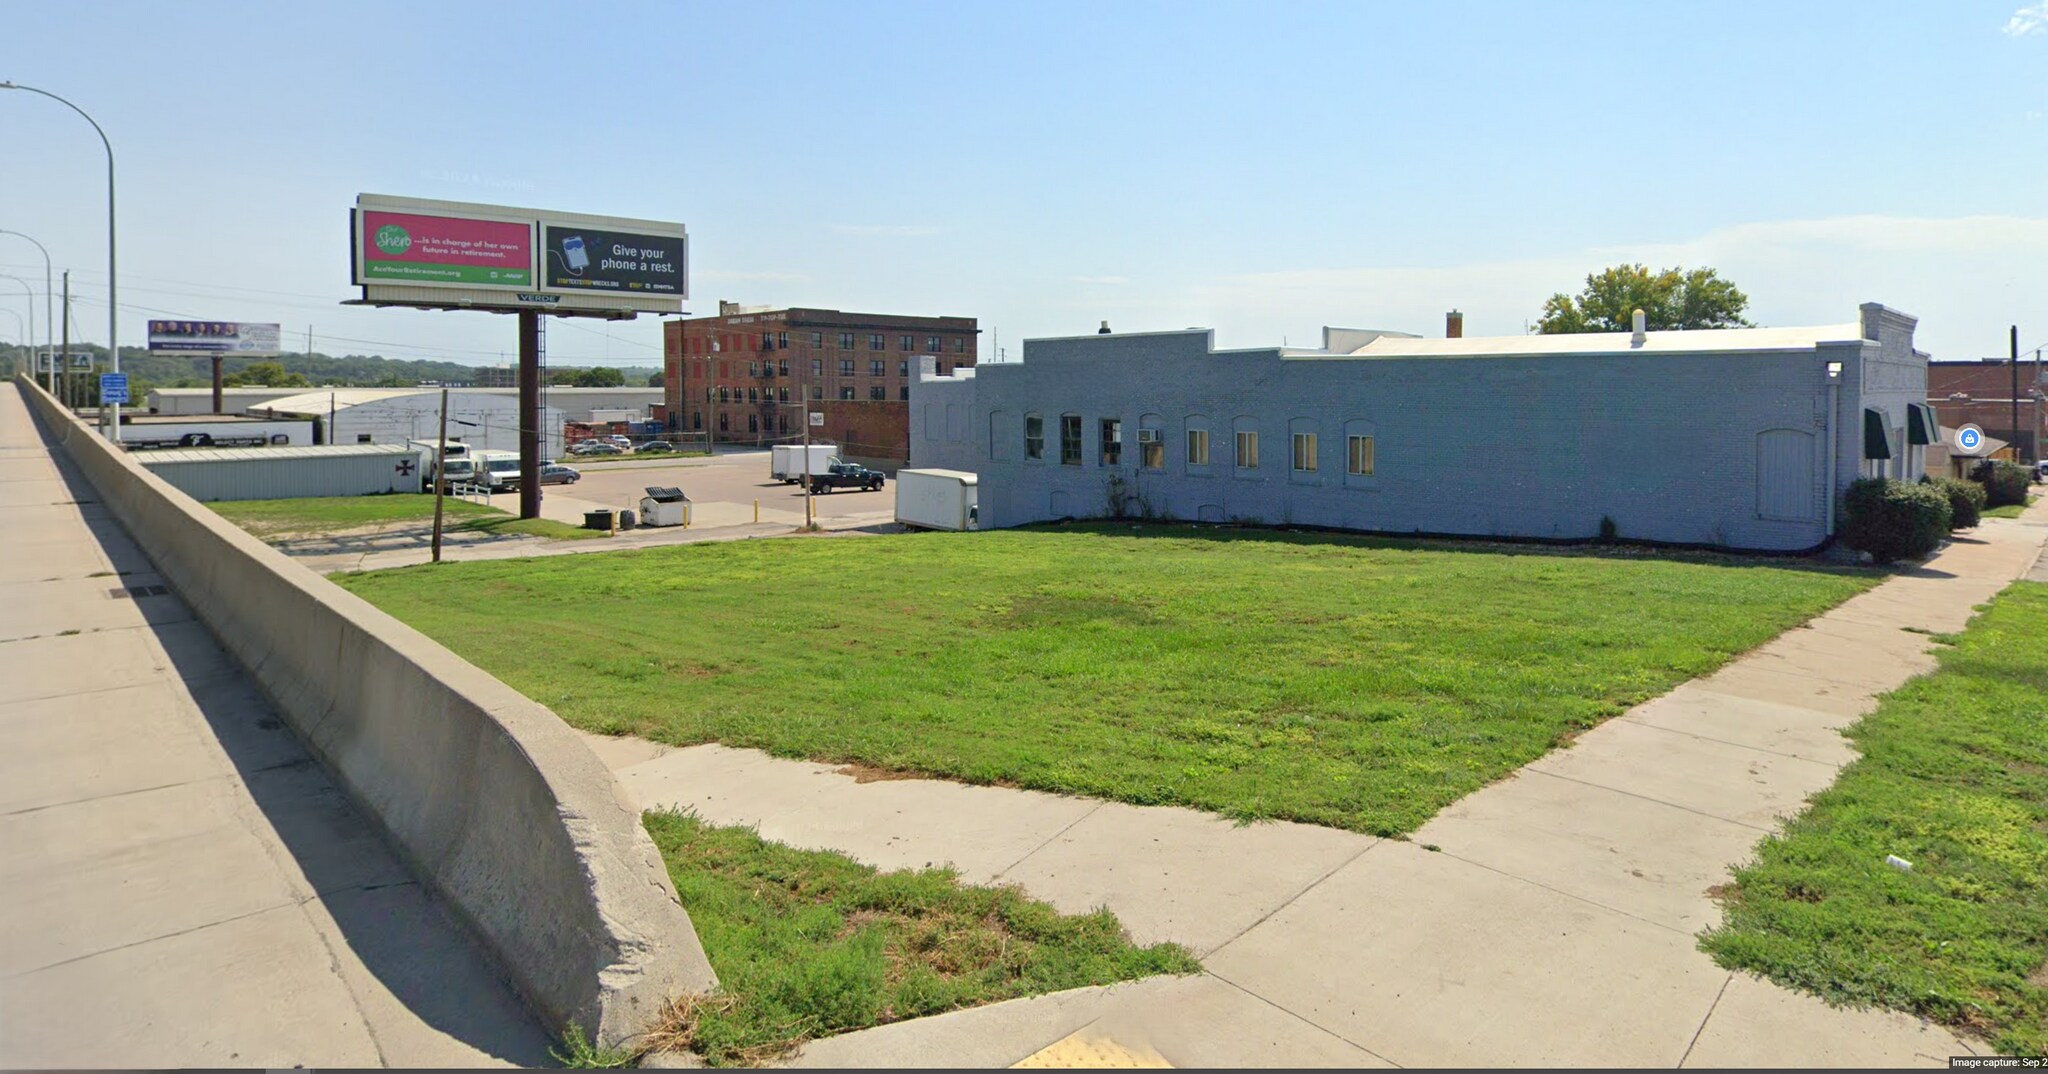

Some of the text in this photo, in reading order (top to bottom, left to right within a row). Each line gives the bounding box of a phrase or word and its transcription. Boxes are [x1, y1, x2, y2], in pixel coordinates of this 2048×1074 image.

[442, 238, 471, 248] charge
[473, 240, 482, 248] of
[422, 246, 449, 254] future
[461, 249, 506, 258] retirement.
[612, 244, 664, 260] Give your
[601, 257, 675, 273] phone a rest.
[520, 294, 556, 302] VERDE
